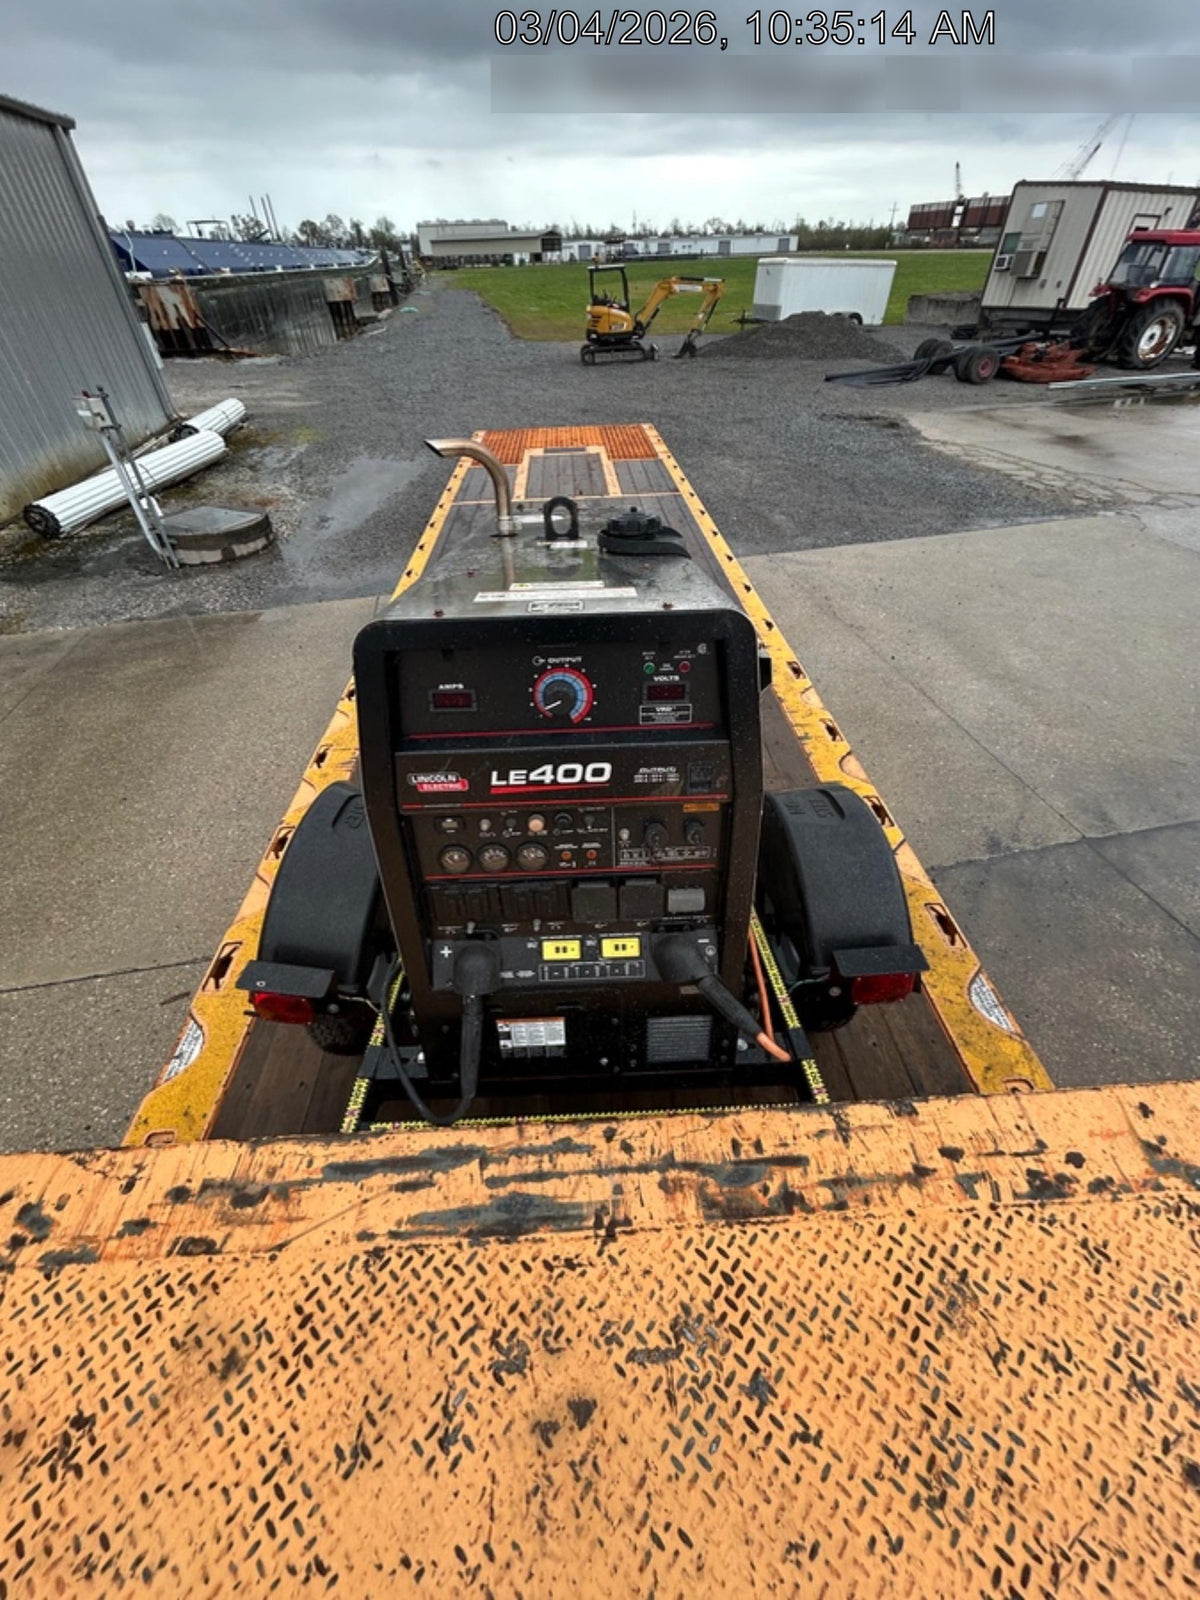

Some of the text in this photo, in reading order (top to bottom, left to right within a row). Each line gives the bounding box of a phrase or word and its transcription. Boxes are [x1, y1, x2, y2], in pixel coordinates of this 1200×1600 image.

[547, 655, 583, 664] OUTPUT
[411, 774, 457, 783] LINCOLN
[490, 762, 613, 786] LE400
